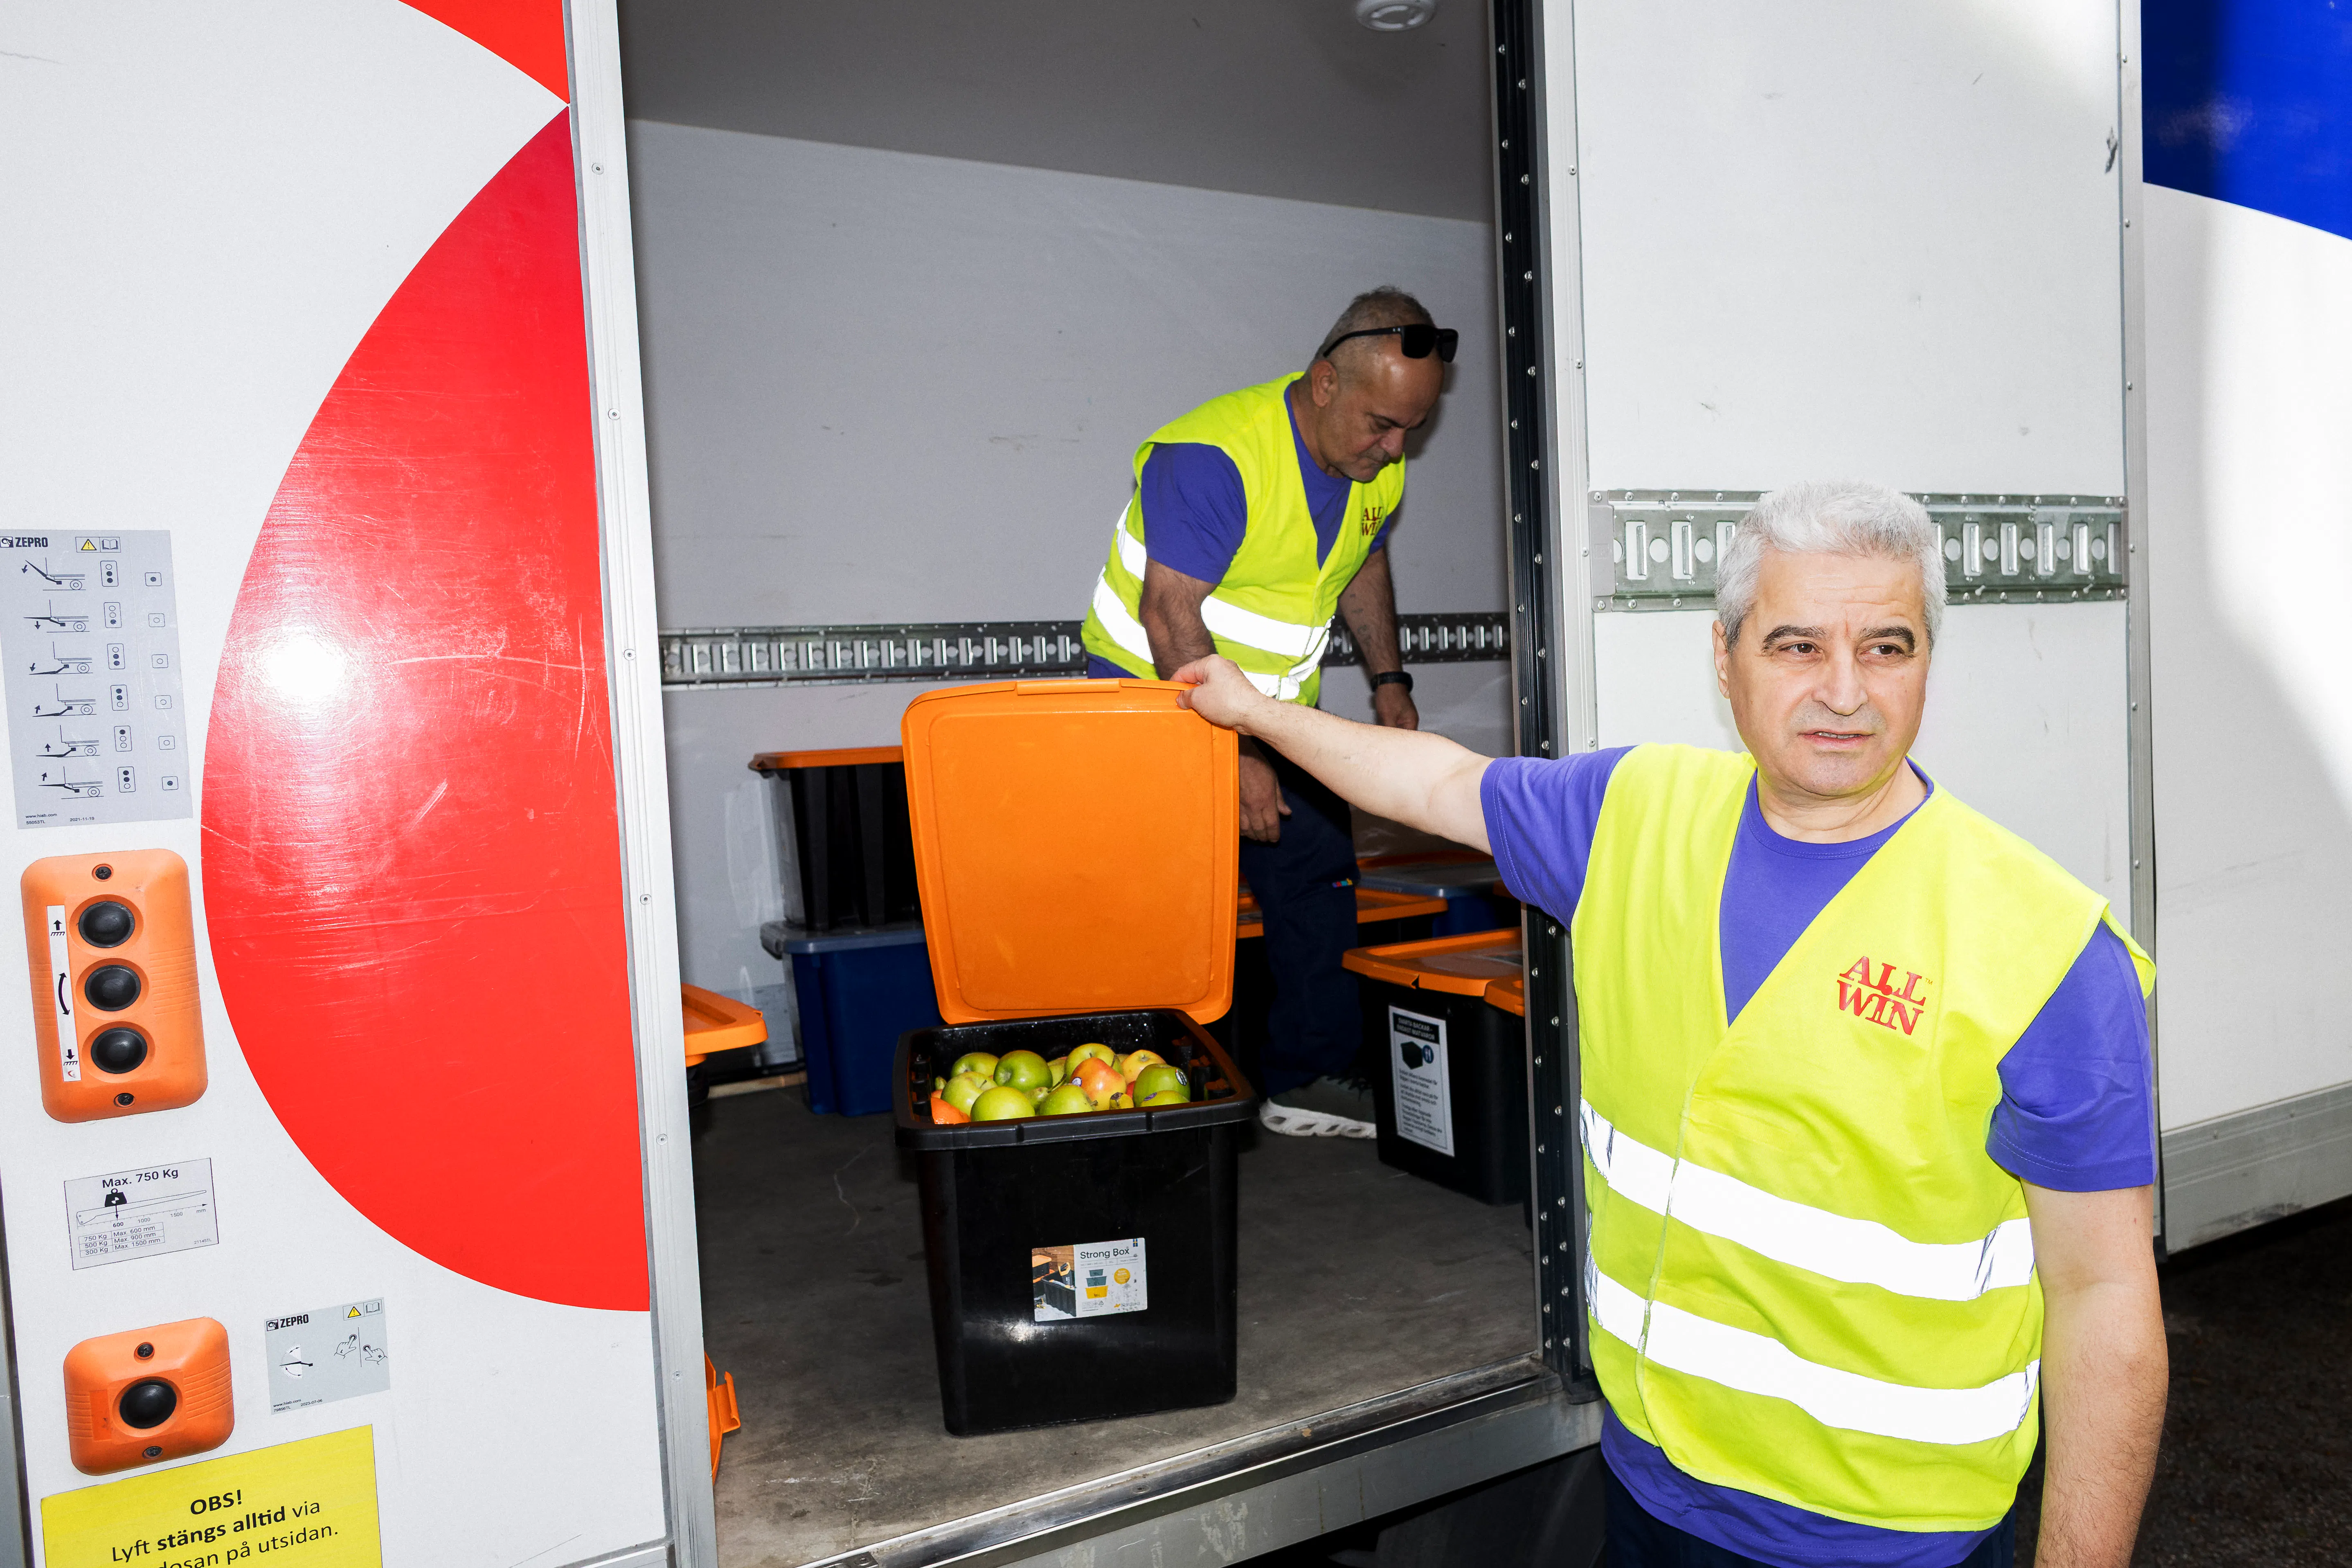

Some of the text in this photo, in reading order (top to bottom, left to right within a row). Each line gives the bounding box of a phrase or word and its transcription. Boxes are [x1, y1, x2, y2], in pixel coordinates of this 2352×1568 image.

[1362, 506, 1383, 521] ALL
[15, 537, 48, 547] ZEPRO
[1839, 956, 1926, 1006] ALL
[1837, 979, 1924, 1036] WIN
[102, 1169, 178, 1188] Max. 750 Kg
[1080, 1251, 1110, 1259] Strong
[280, 1314, 309, 1328] ZEPRO
[190, 1489, 242, 1514] OBS!
[112, 1501, 320, 1563] Lyft stängs alltid via
[227, 1541, 250, 1565] på
[259, 1526, 338, 1553] utsidan.
